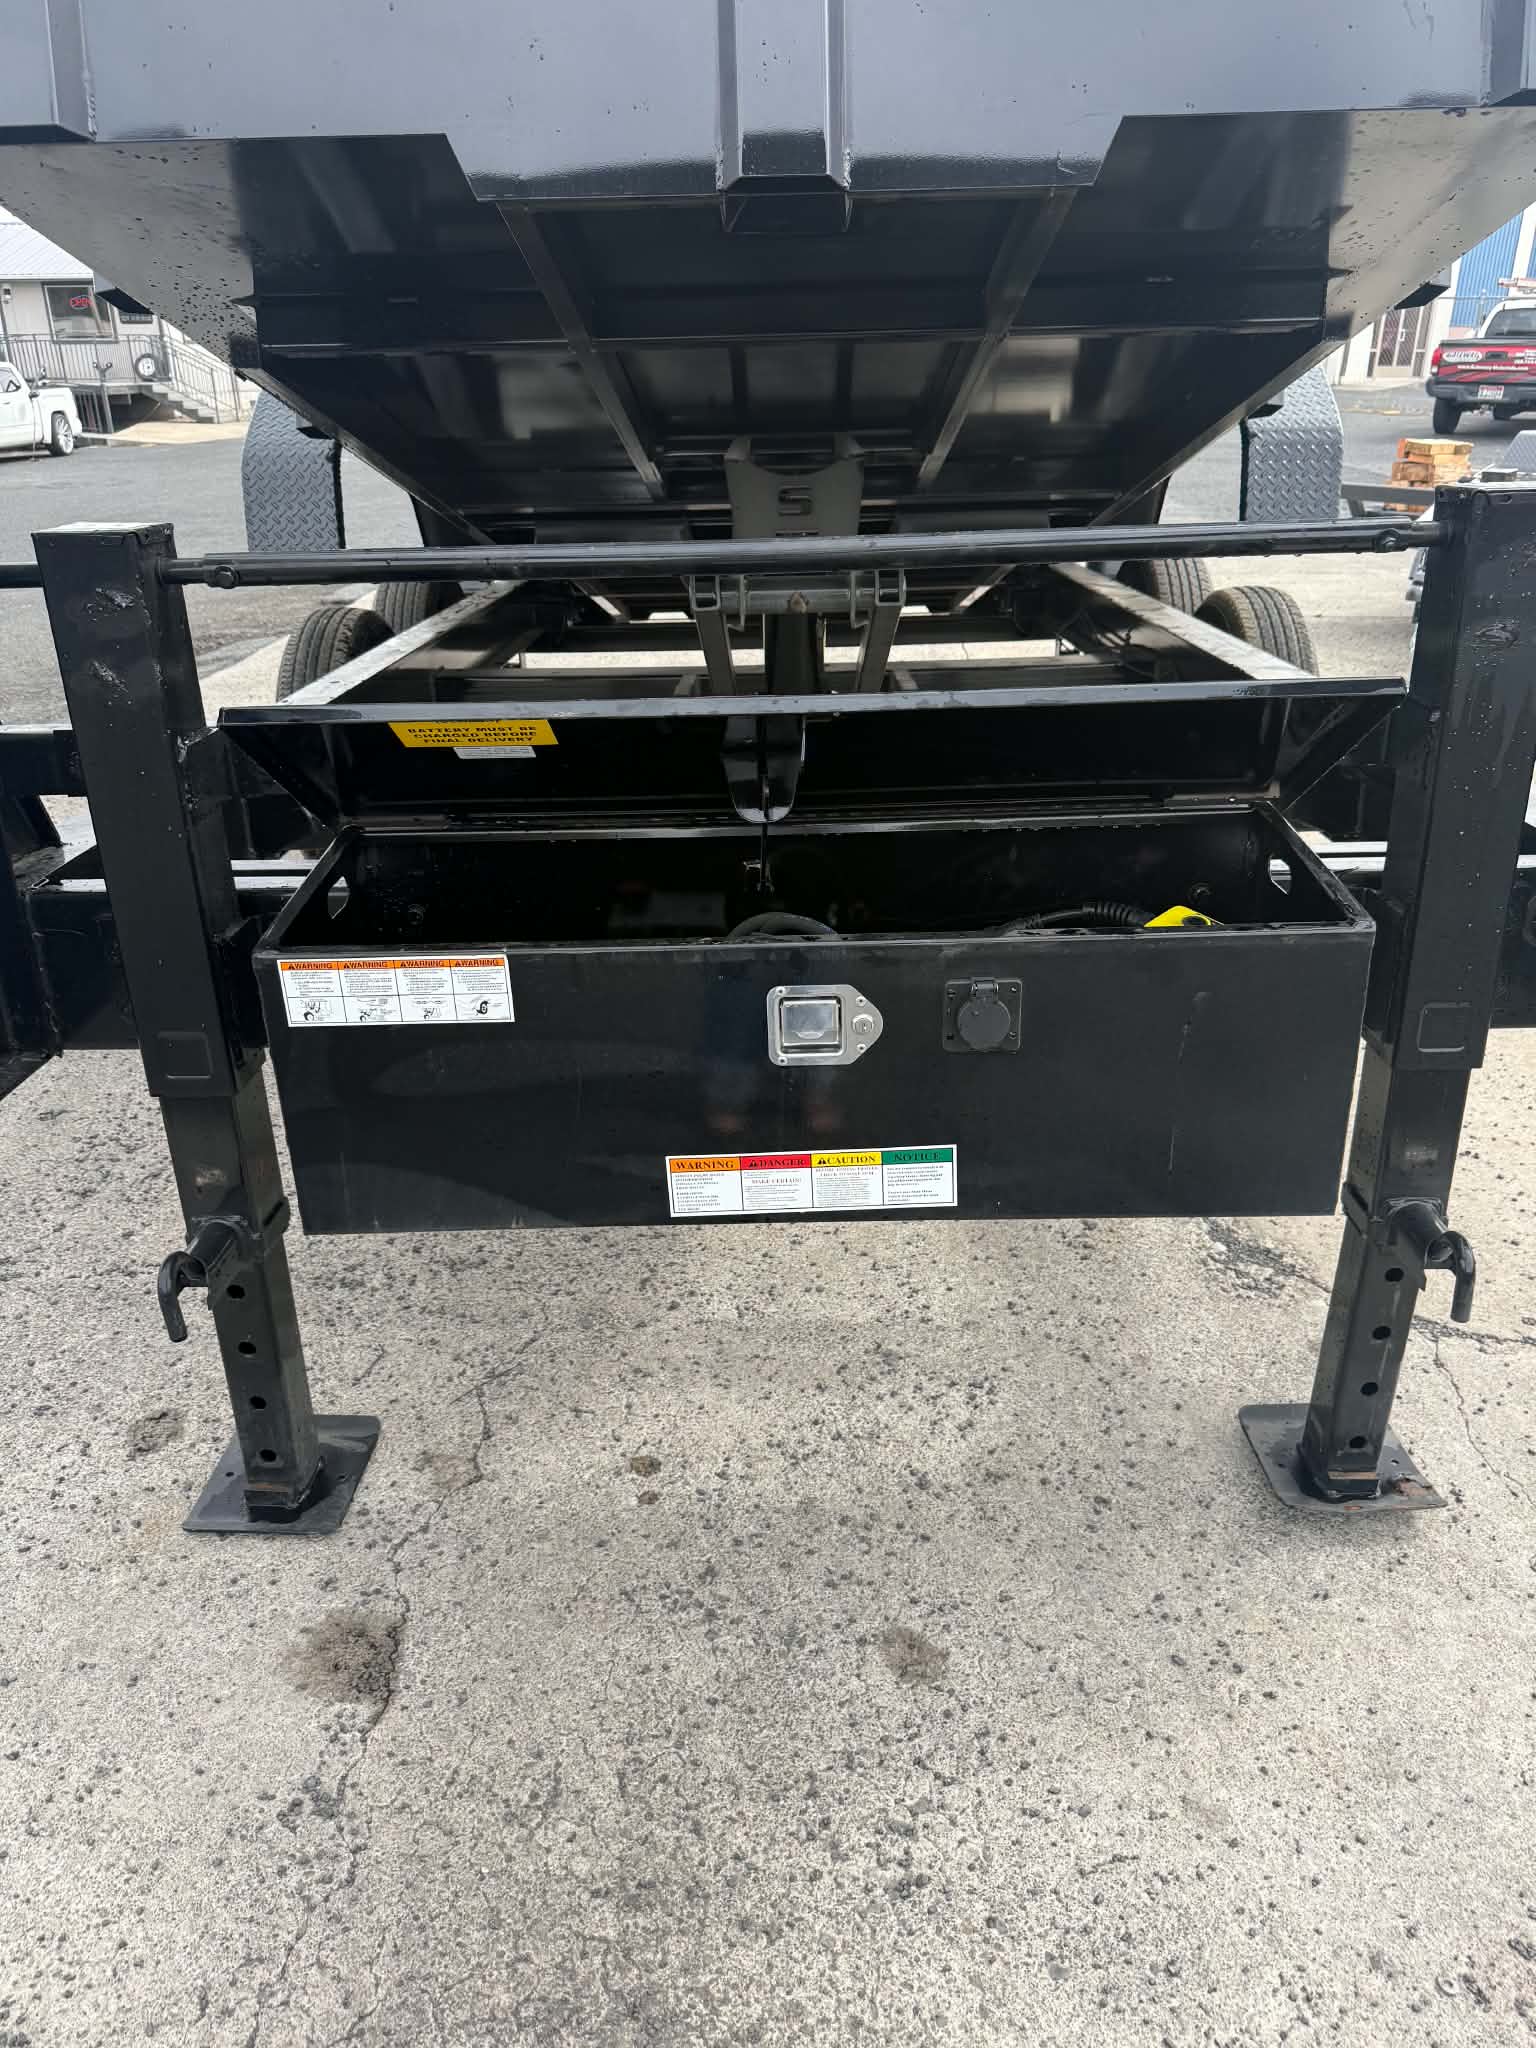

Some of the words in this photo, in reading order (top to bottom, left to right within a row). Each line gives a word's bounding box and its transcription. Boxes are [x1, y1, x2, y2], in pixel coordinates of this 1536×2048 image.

[778, 485, 813, 517] S
[294, 962, 333, 970] WARNING
[350, 961, 387, 969] WARNING
[827, 1155, 876, 1164] CAUTION
[895, 1151, 941, 1161] NOTICE
[676, 1160, 734, 1170] WARNING
[760, 1159, 804, 1167] DANGER
